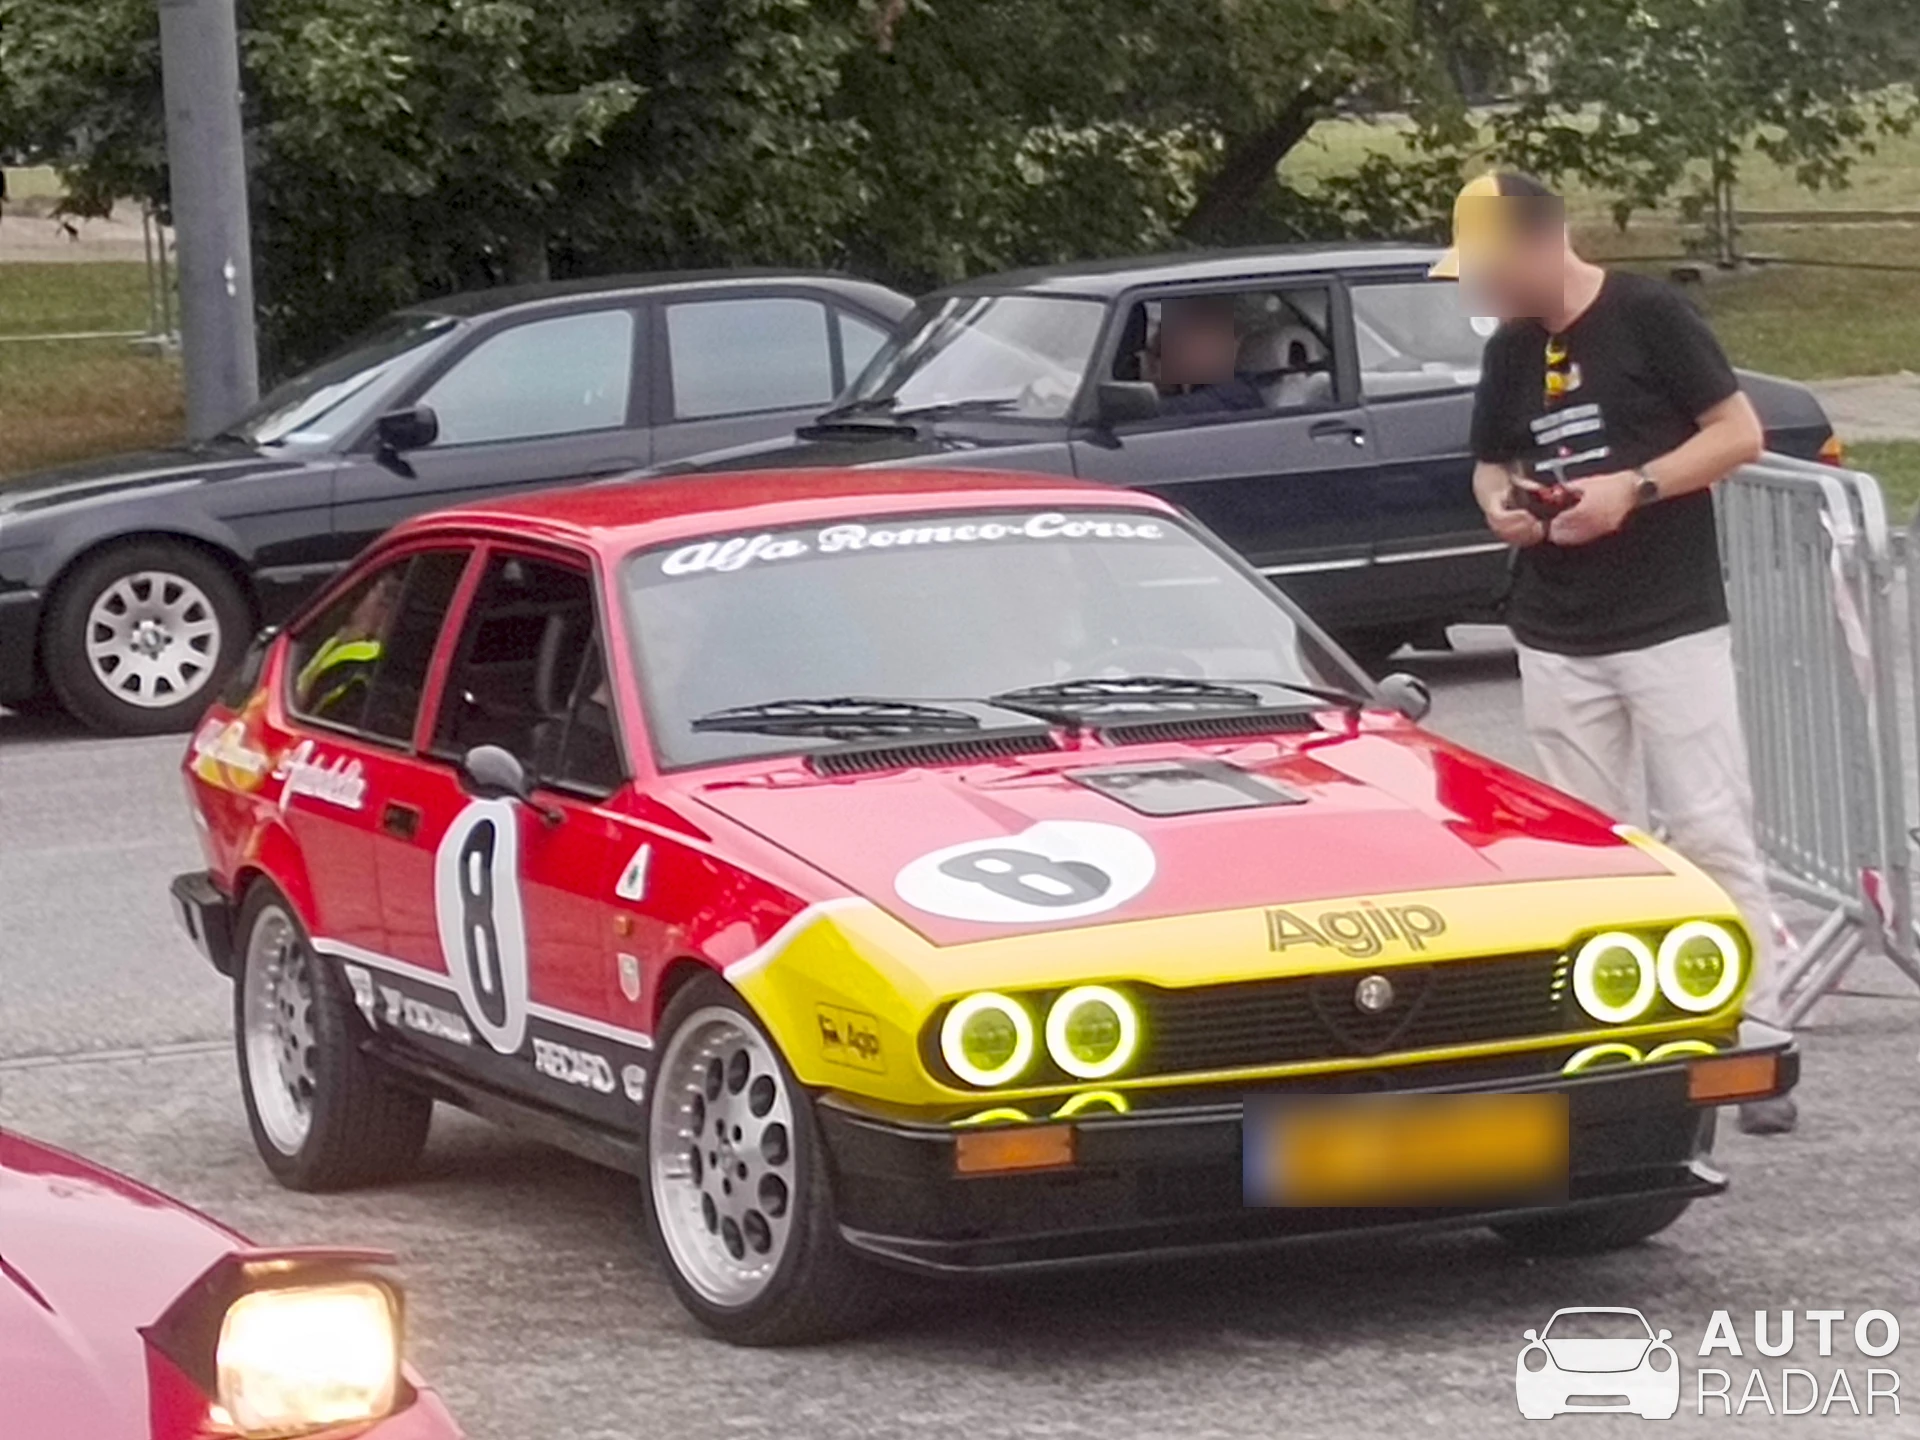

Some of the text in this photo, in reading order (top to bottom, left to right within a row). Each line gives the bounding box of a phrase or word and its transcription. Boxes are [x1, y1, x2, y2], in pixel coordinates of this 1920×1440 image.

[661, 534, 809, 576] Alfa
[938, 848, 1111, 907] 8
[459, 819, 507, 1029] 8
[1265, 901, 1446, 958] Agip
